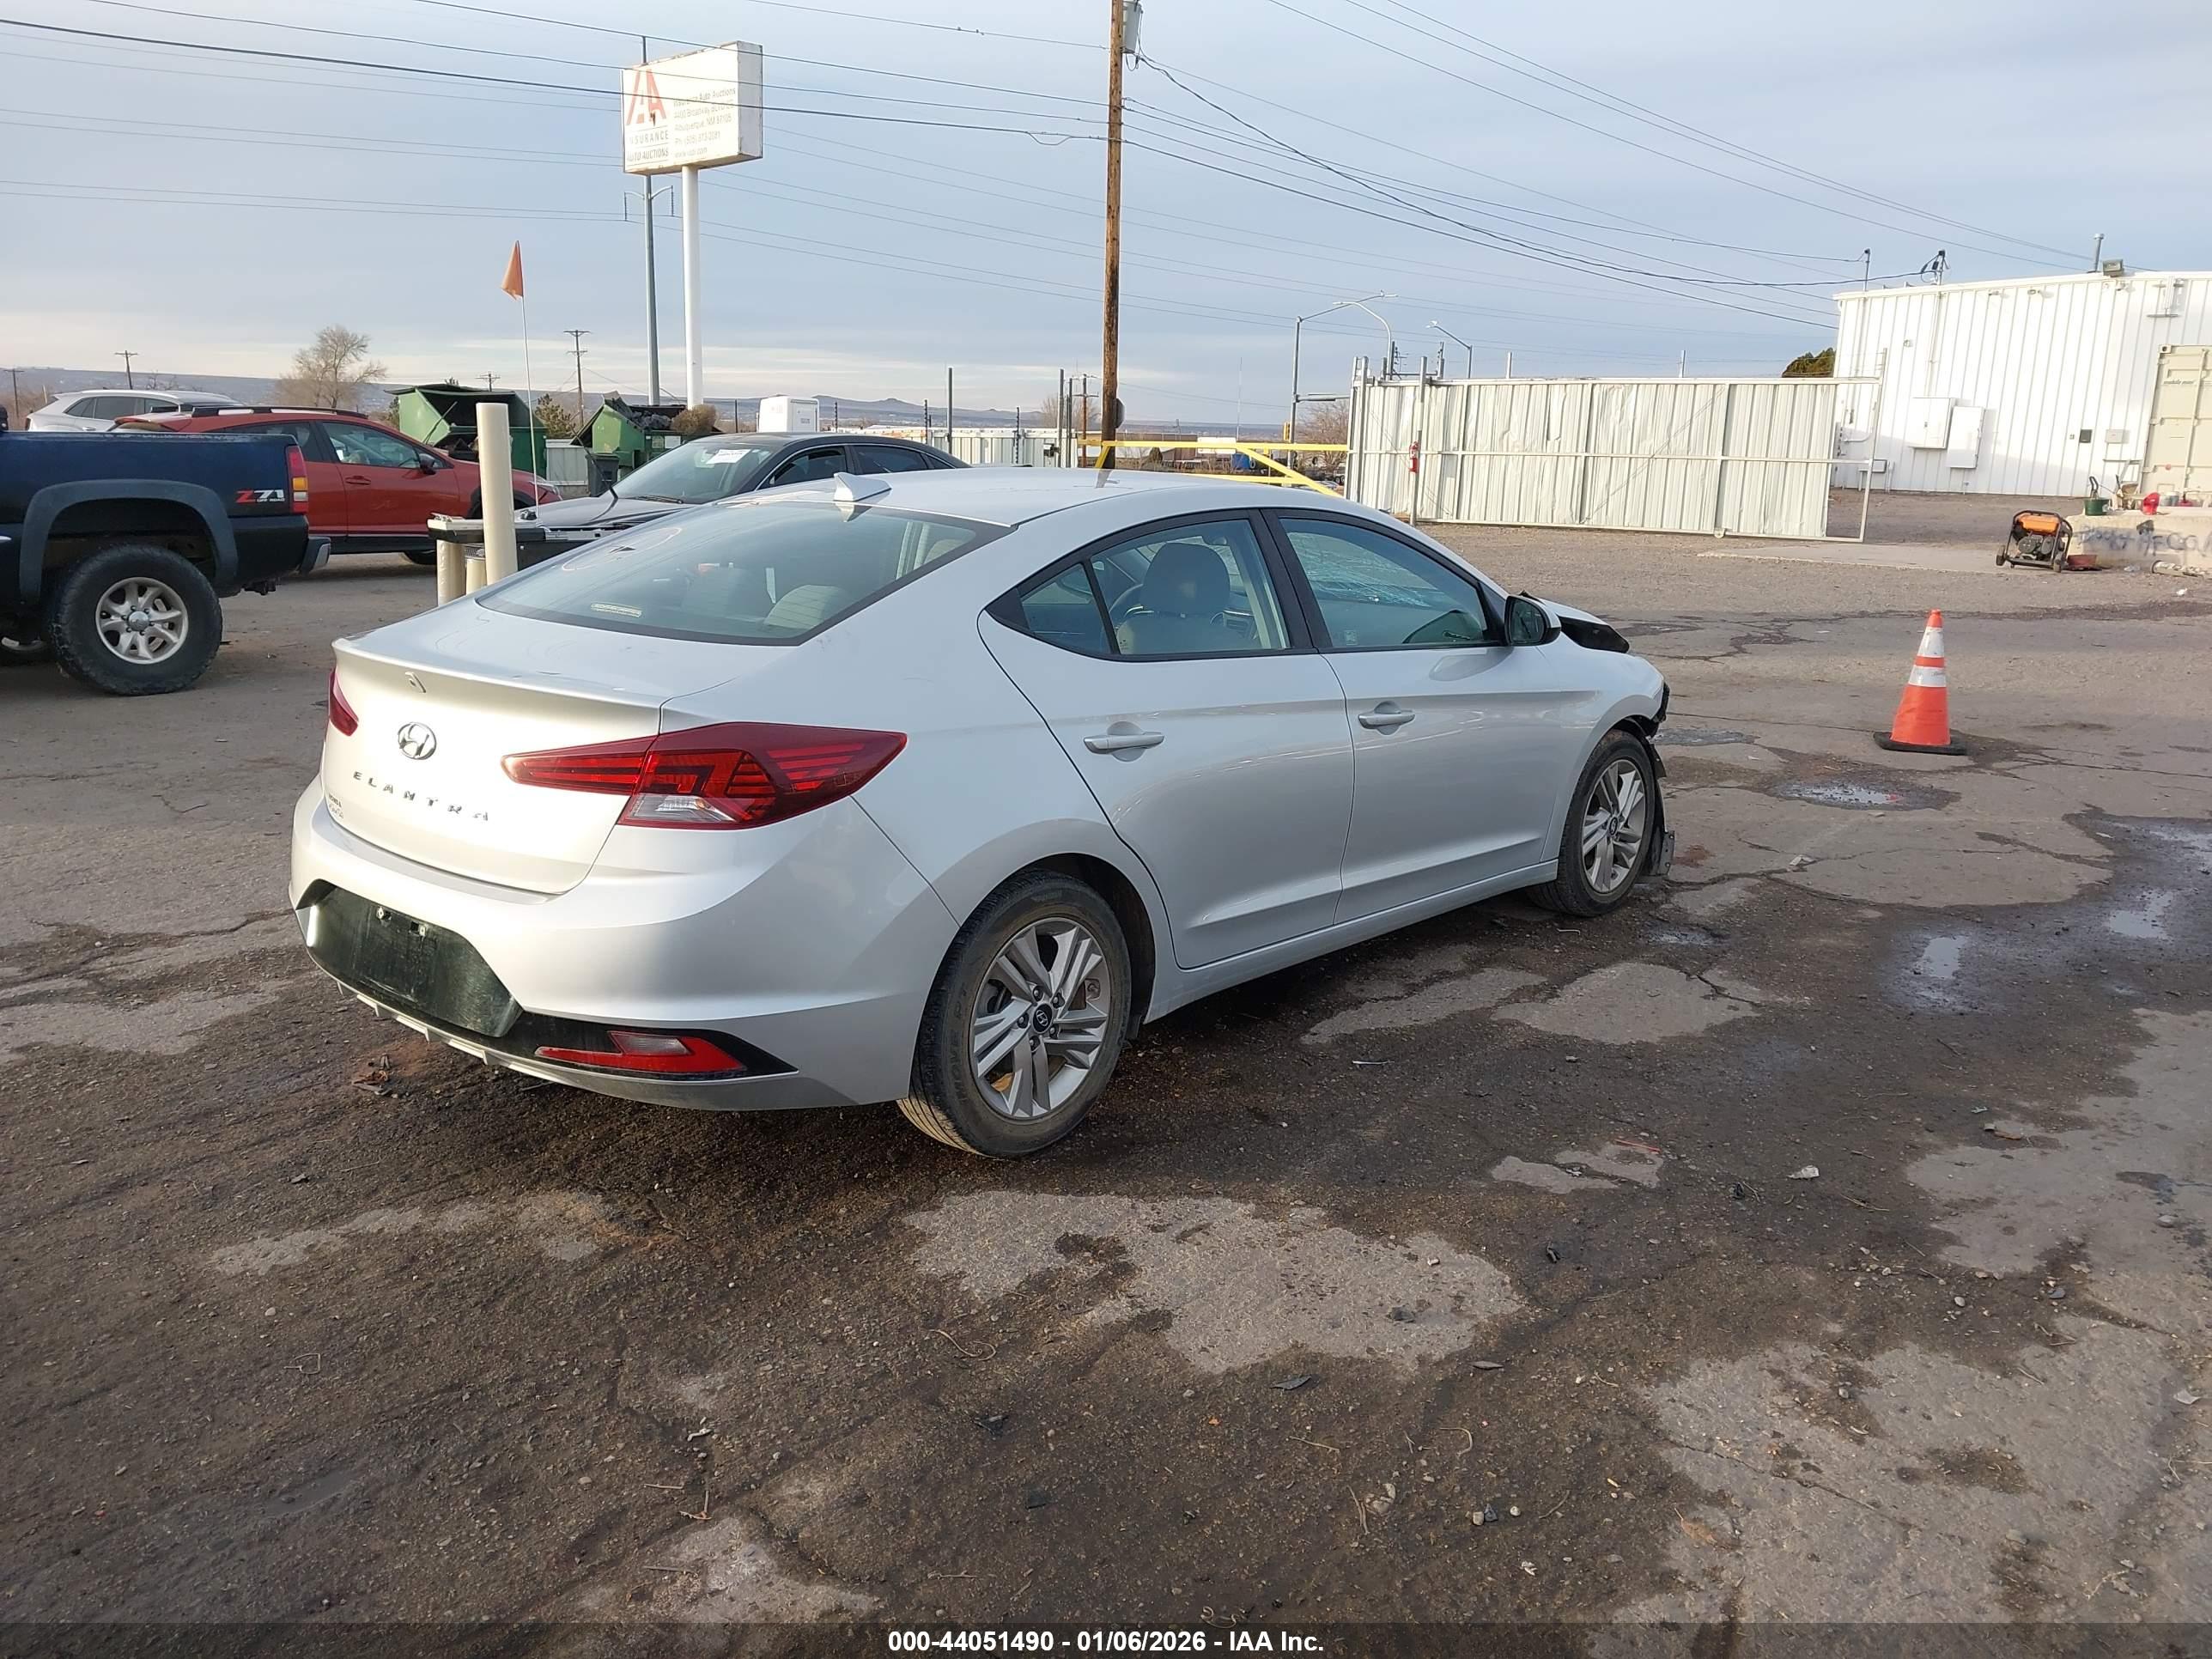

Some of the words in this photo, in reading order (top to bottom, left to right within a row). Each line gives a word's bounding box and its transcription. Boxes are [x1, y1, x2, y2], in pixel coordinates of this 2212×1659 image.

[713, 88, 736, 97] Auctions
[642, 148, 669, 161] AUCTIONS
[235, 489, 284, 503] Z71
[352, 770, 489, 822] ELANTRA
